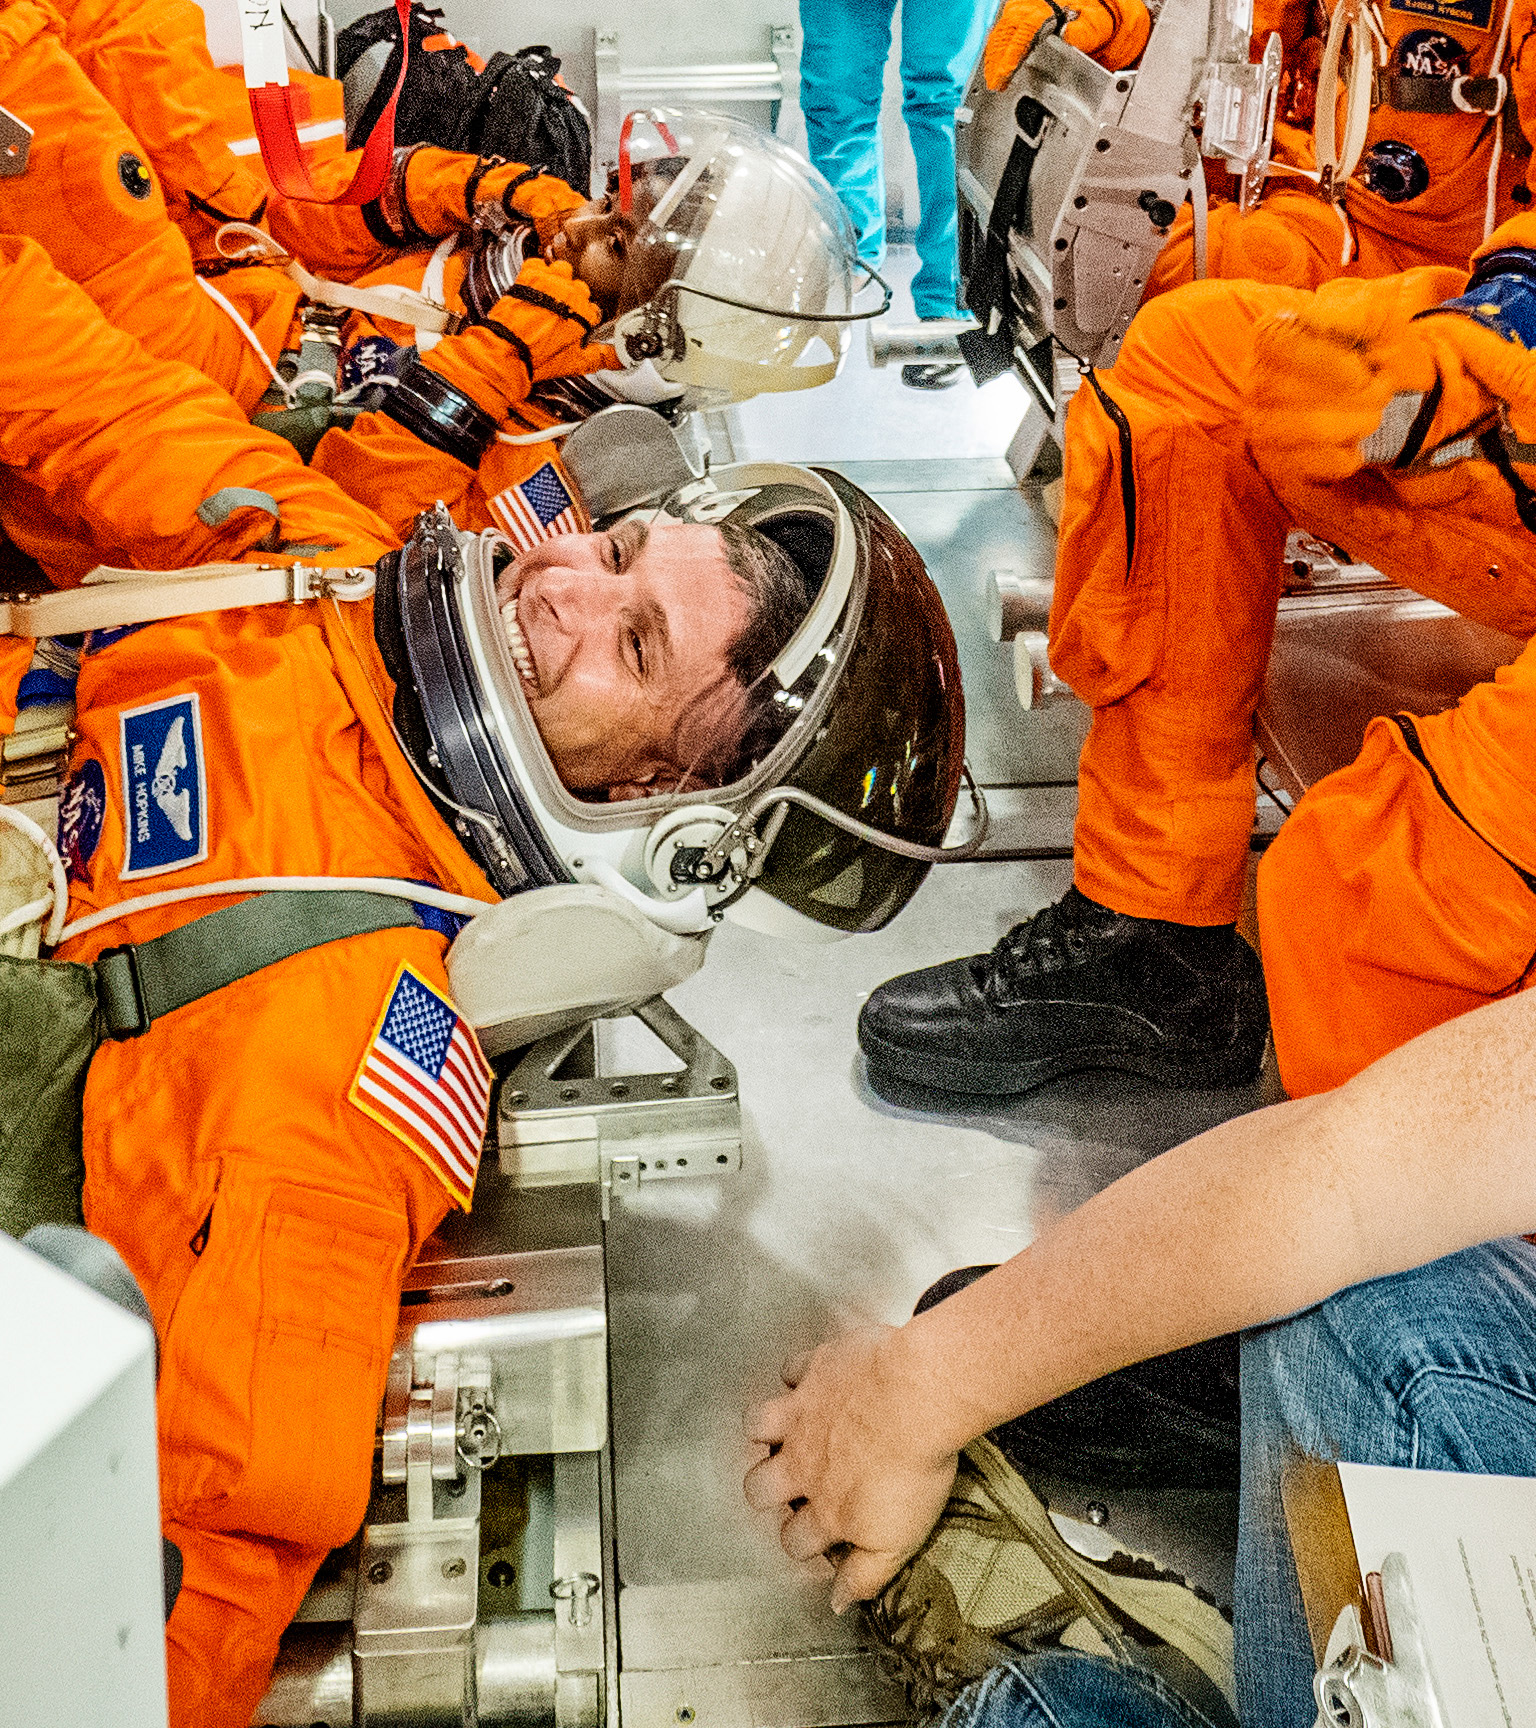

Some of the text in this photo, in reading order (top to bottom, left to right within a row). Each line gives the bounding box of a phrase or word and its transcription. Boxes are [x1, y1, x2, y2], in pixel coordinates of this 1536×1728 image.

[1404, 51, 1462, 81] NASA
[131, 743, 152, 844] MIKE HOPKINS
